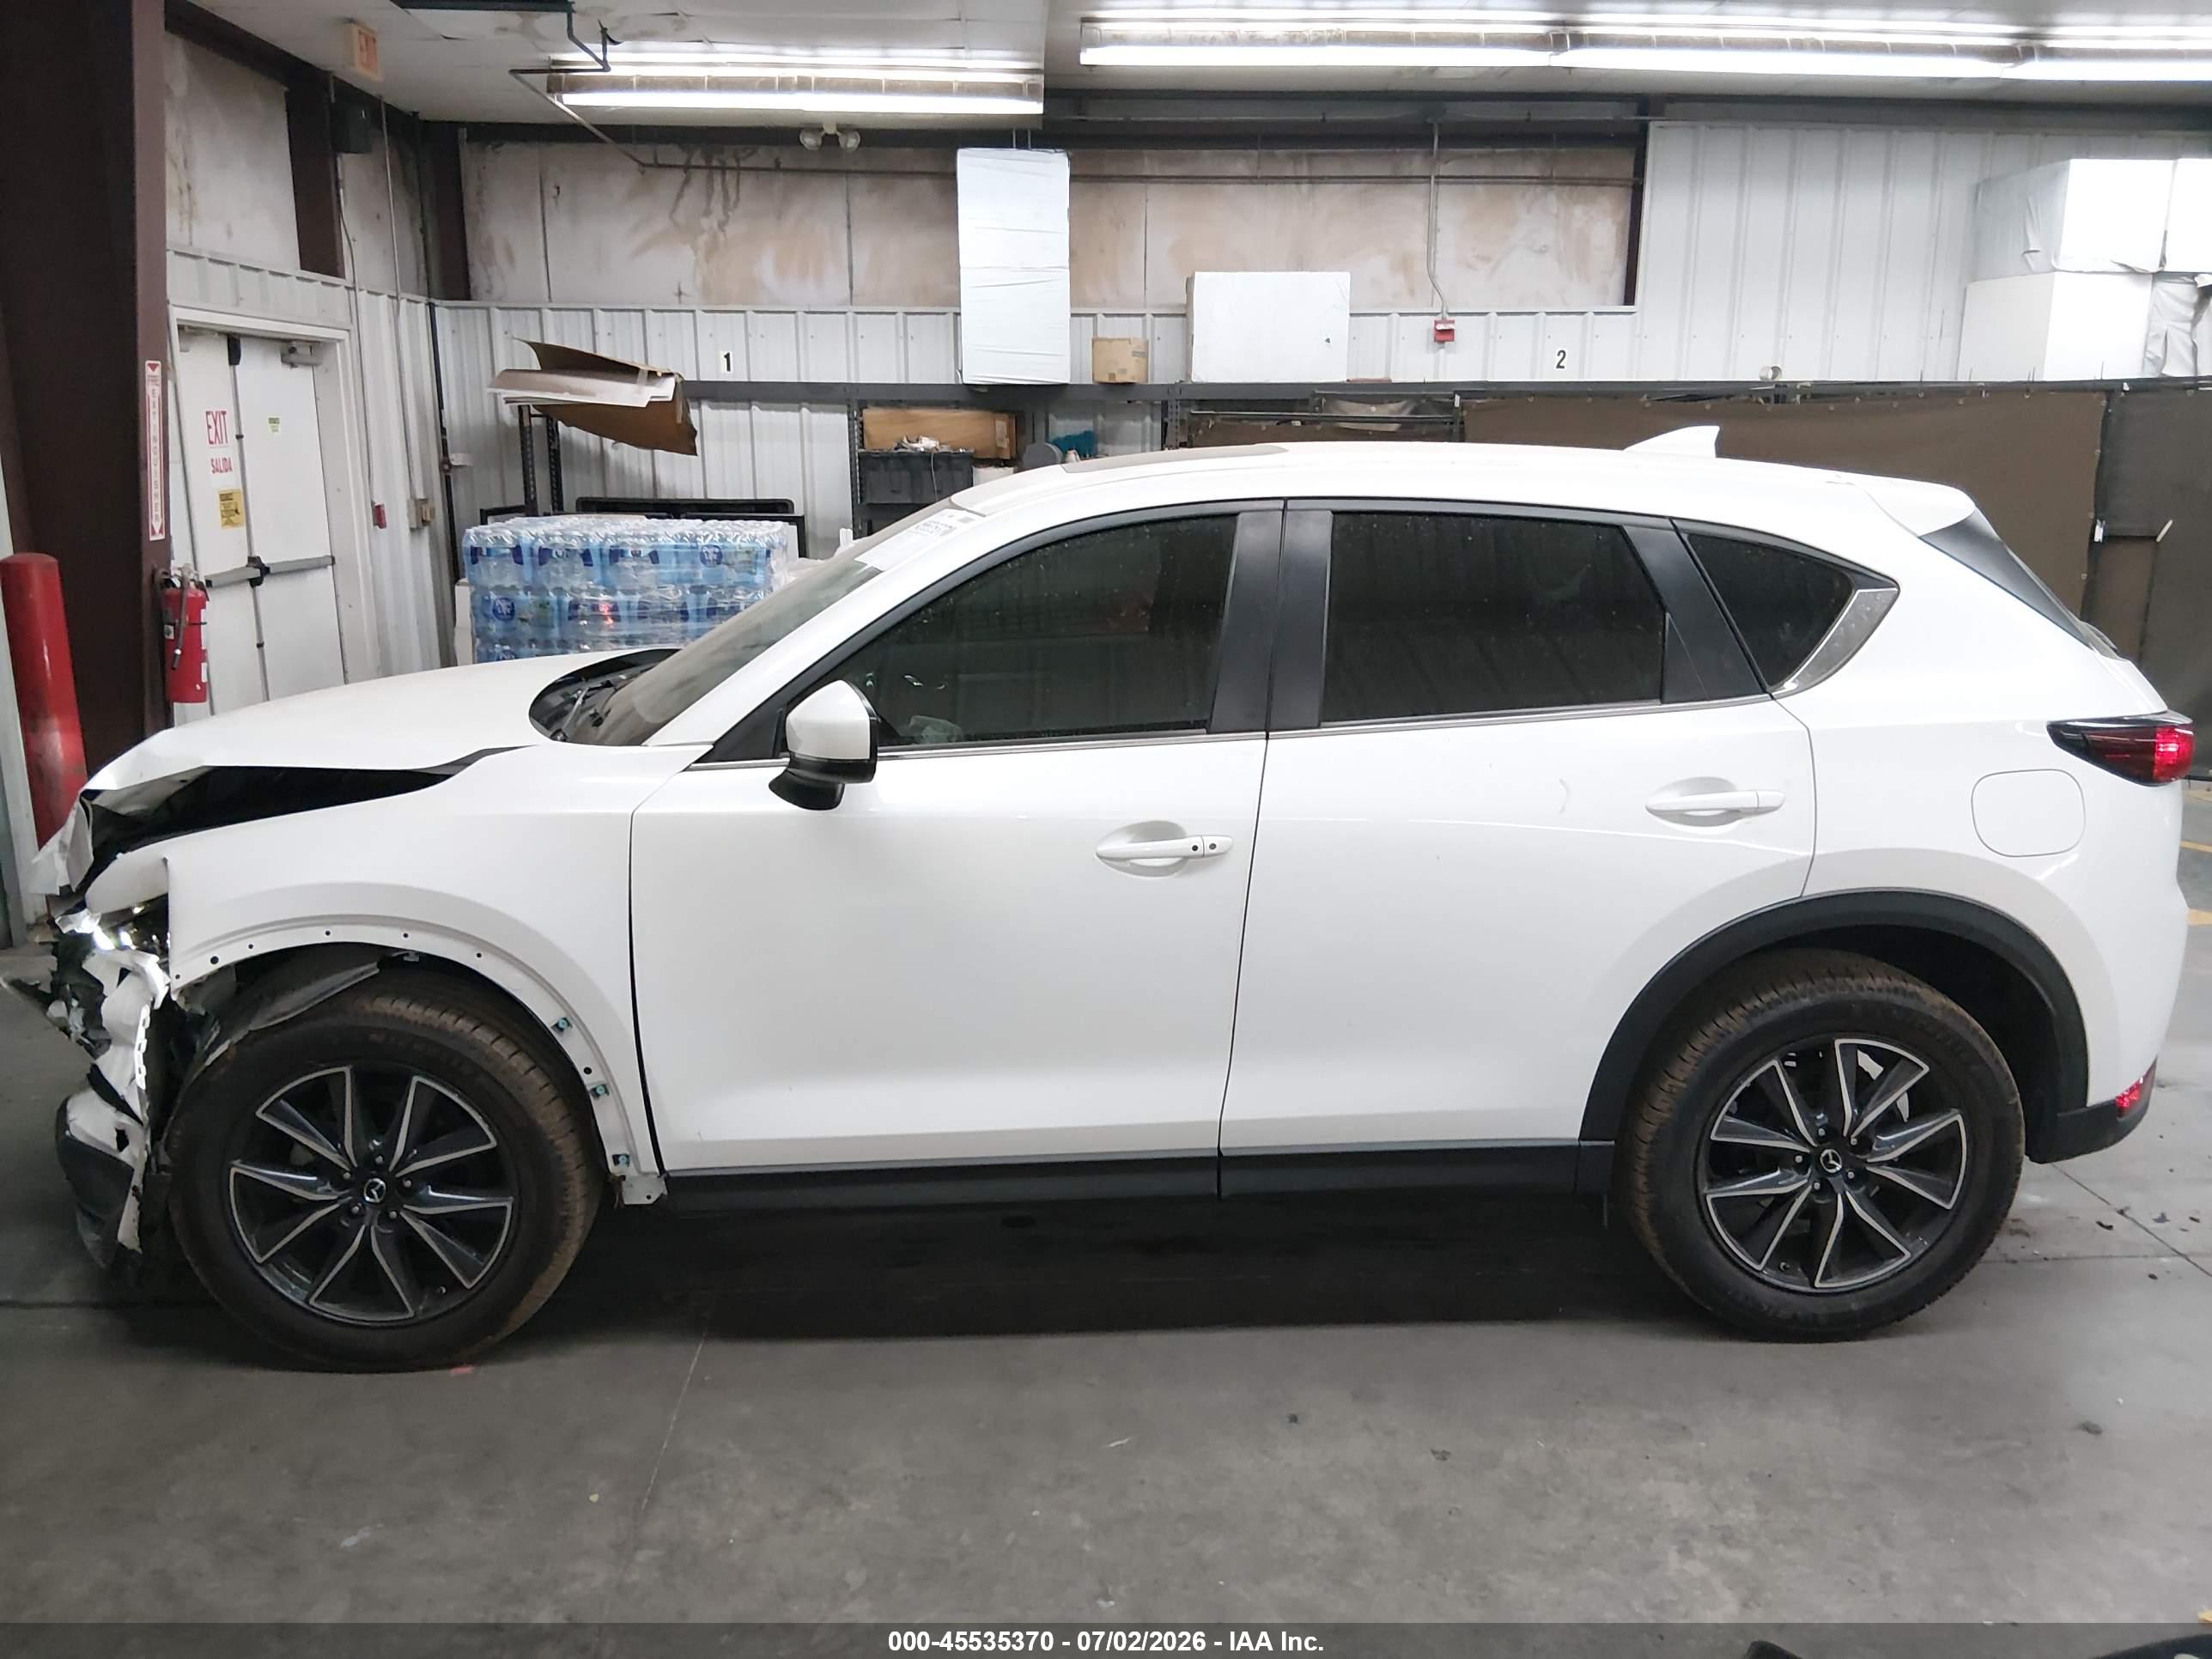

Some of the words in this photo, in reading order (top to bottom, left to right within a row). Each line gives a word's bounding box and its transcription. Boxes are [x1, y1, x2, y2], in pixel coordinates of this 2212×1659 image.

[723, 351, 732, 372] 1
[1555, 349, 1567, 369] 2
[205, 410, 228, 446] EXIT
[210, 457, 233, 474] SALIDA
